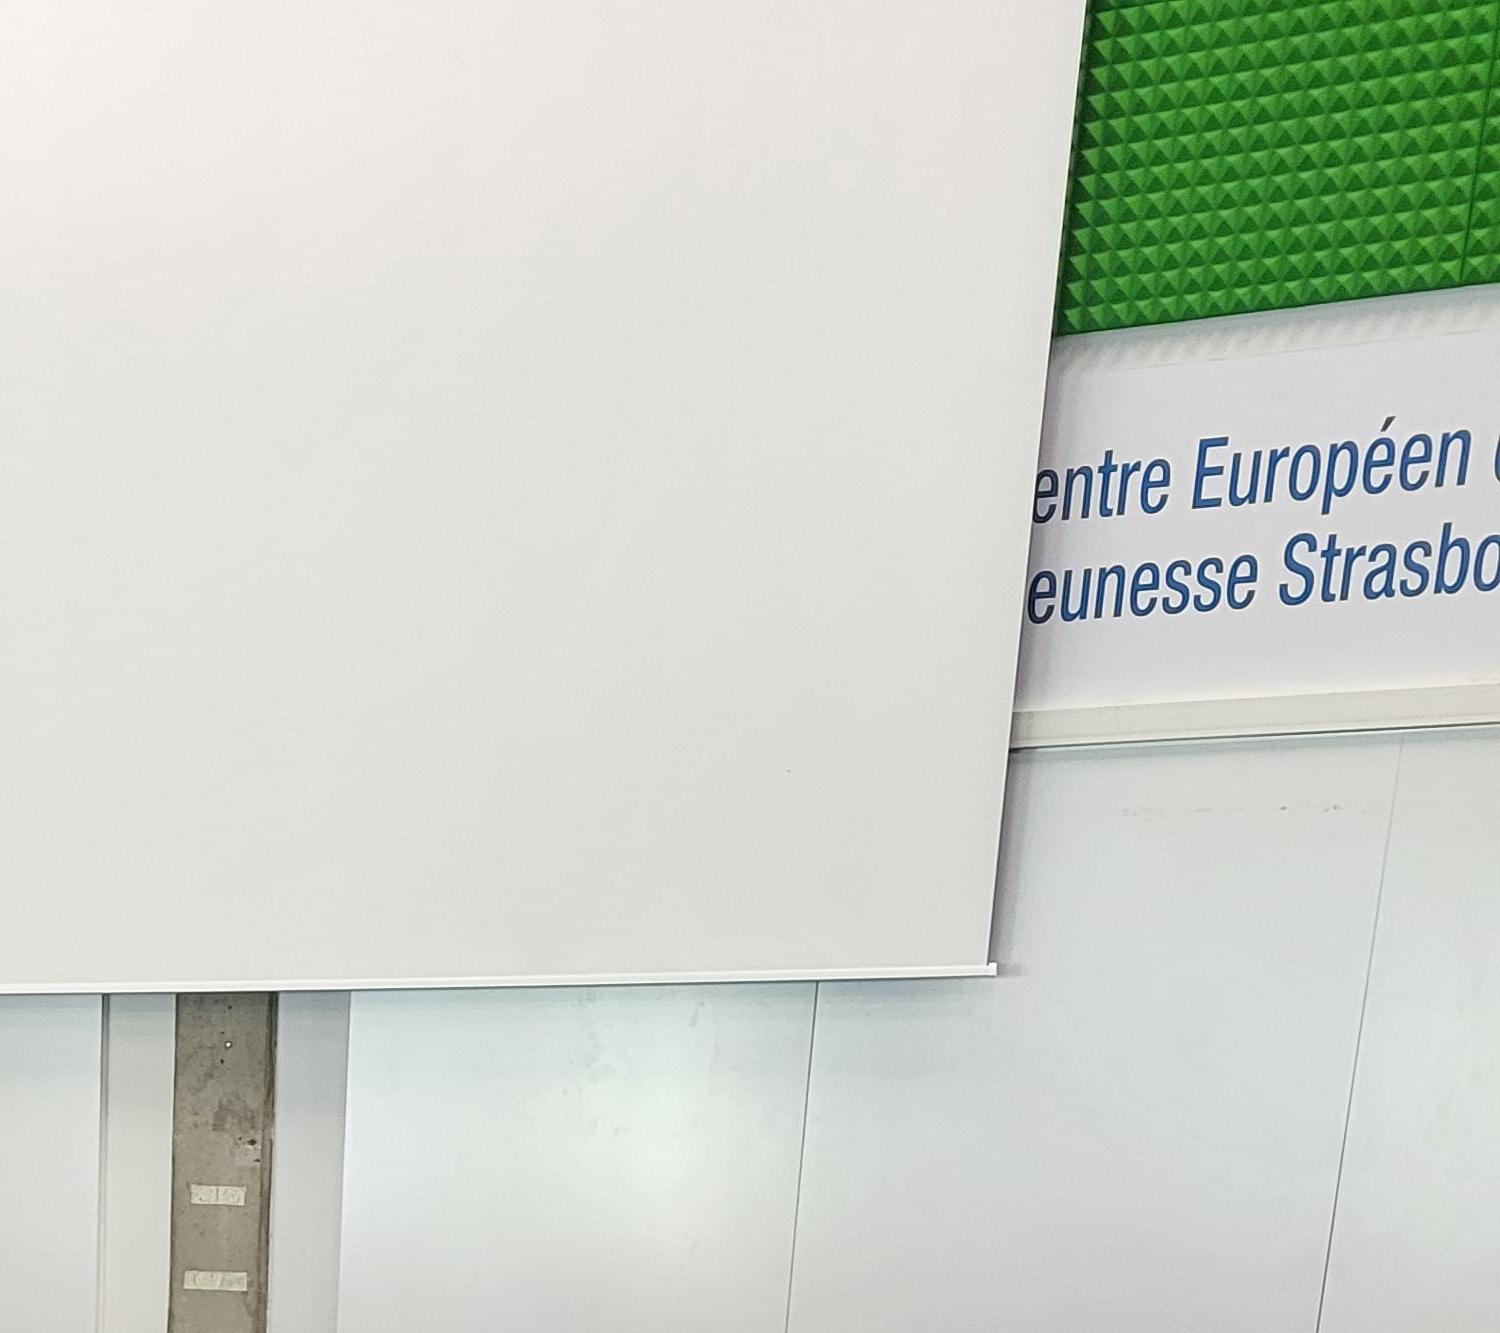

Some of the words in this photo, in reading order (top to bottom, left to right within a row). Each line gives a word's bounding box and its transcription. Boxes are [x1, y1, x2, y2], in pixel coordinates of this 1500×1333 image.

[1031, 450, 1171, 524] entre
[1191, 415, 1472, 515] Européen
[1027, 554, 1259, 624] eunesse
[1279, 522, 1500, 605] Strasbo
